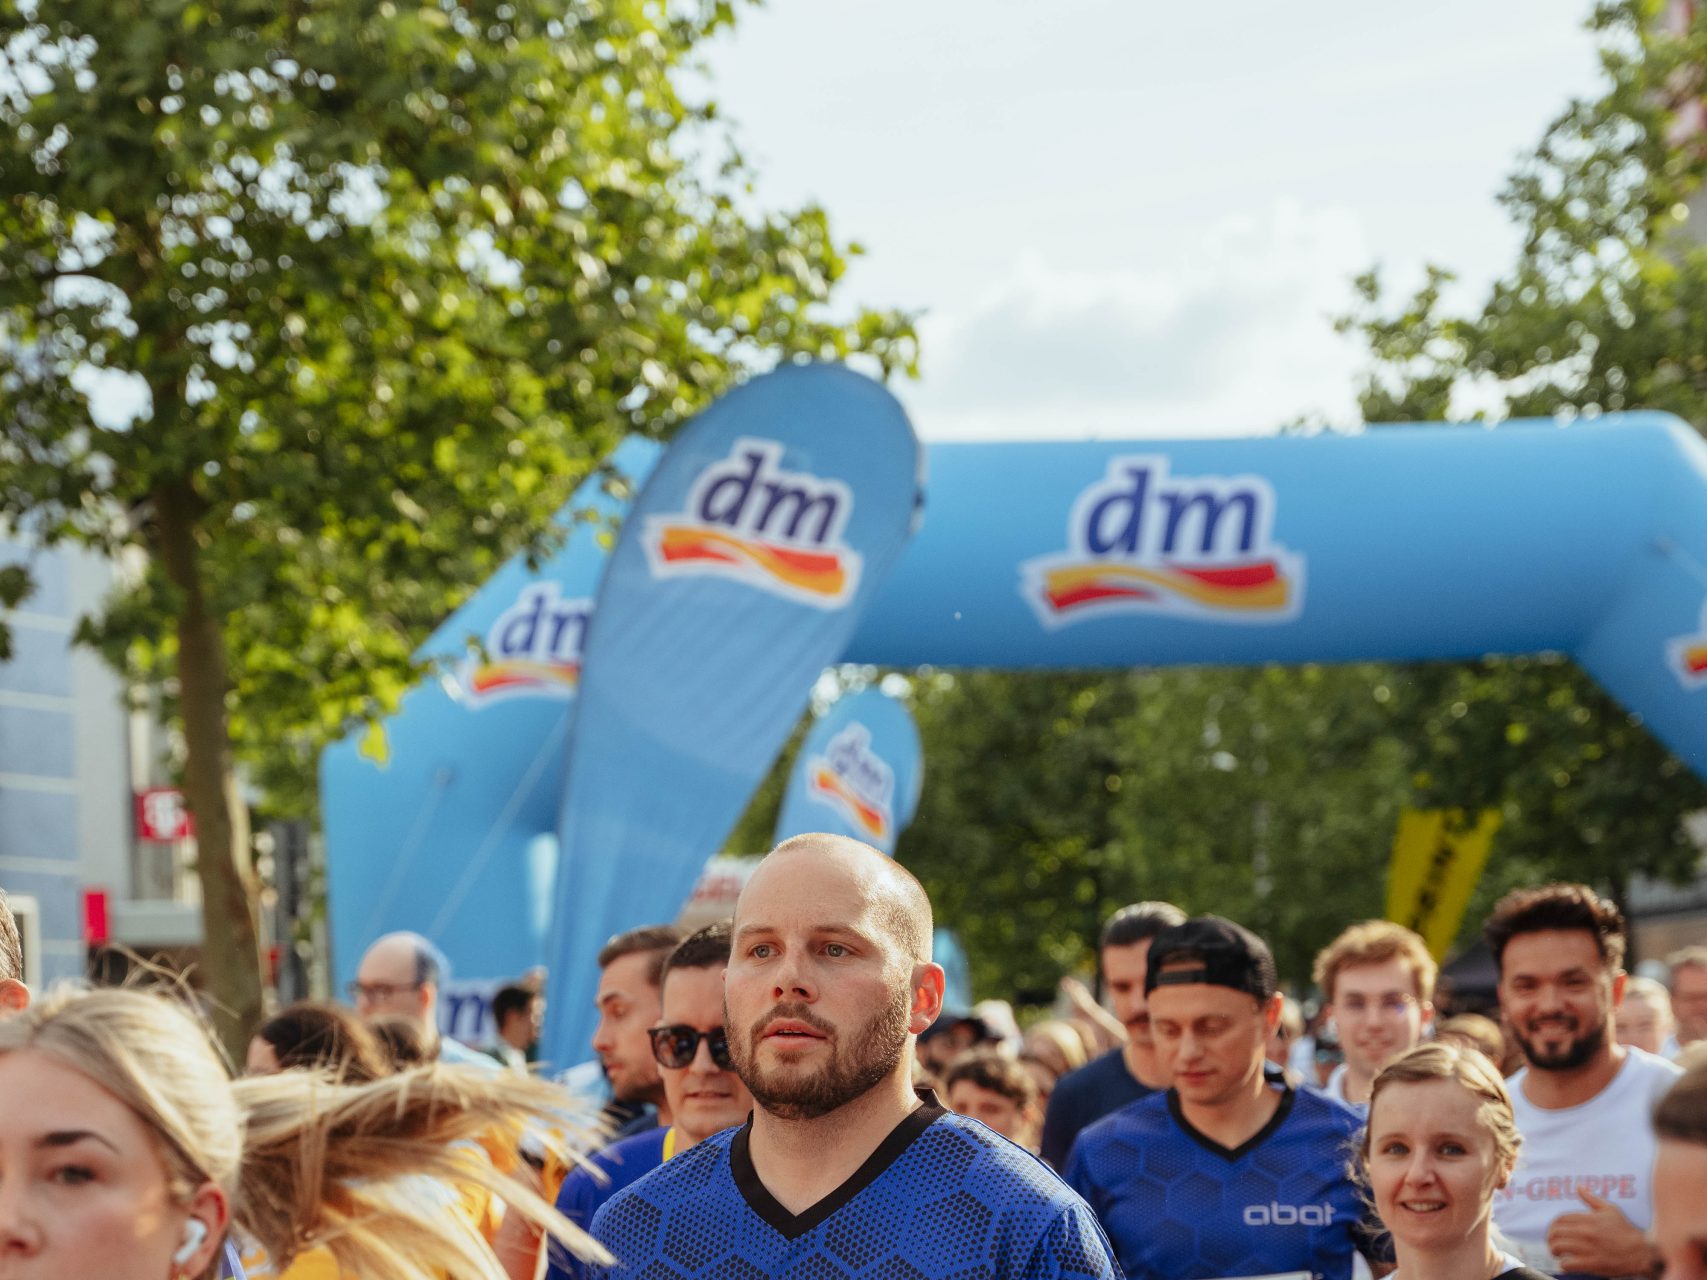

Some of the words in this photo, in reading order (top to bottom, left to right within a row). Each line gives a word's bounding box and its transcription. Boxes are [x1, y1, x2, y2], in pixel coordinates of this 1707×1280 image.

[697, 451, 841, 544] dm
[1086, 466, 1261, 557] dm
[1243, 1201, 1336, 1226] abat
